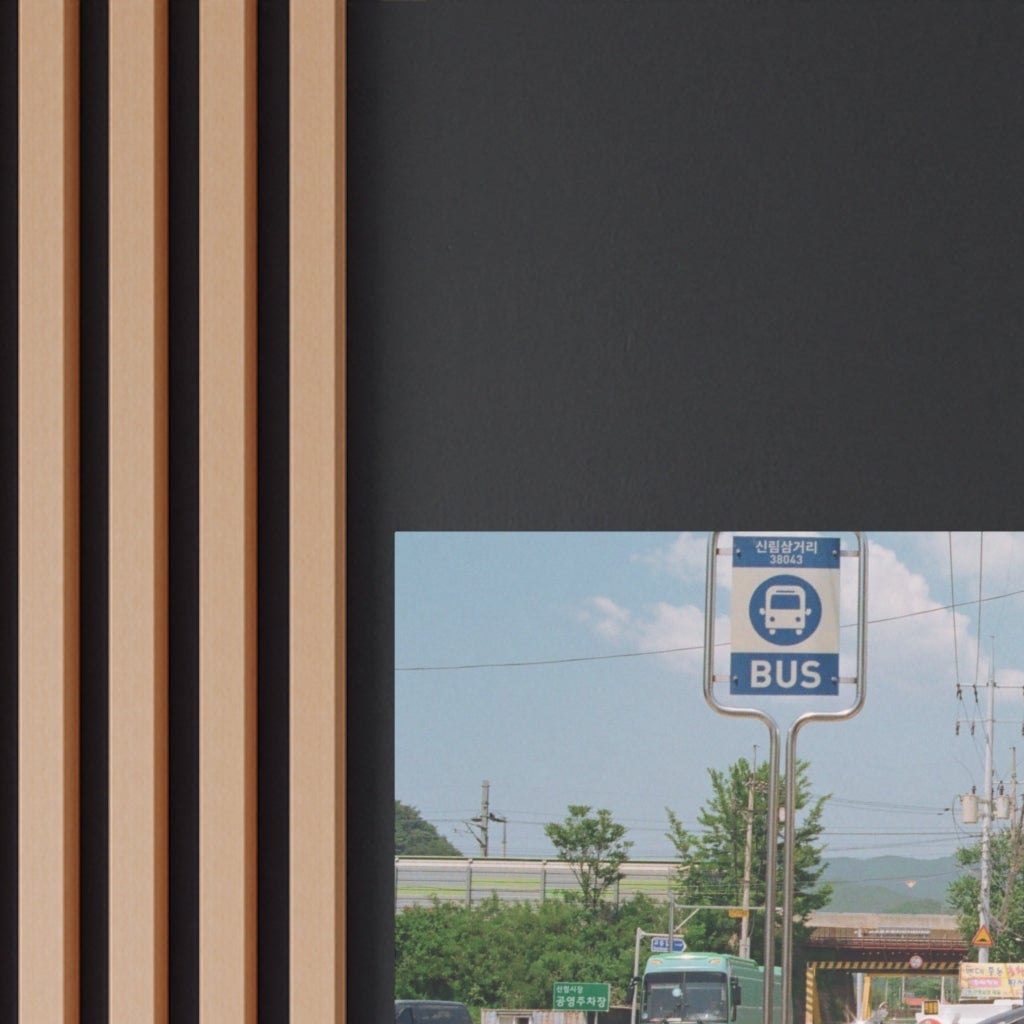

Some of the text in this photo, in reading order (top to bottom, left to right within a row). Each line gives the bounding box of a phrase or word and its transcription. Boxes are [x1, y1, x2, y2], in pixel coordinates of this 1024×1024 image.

[755, 540, 818, 555] 신림삼거리
[769, 554, 804, 565] 38043
[750, 659, 821, 689] BUS
[555, 996, 607, 1008] 공영주차장
